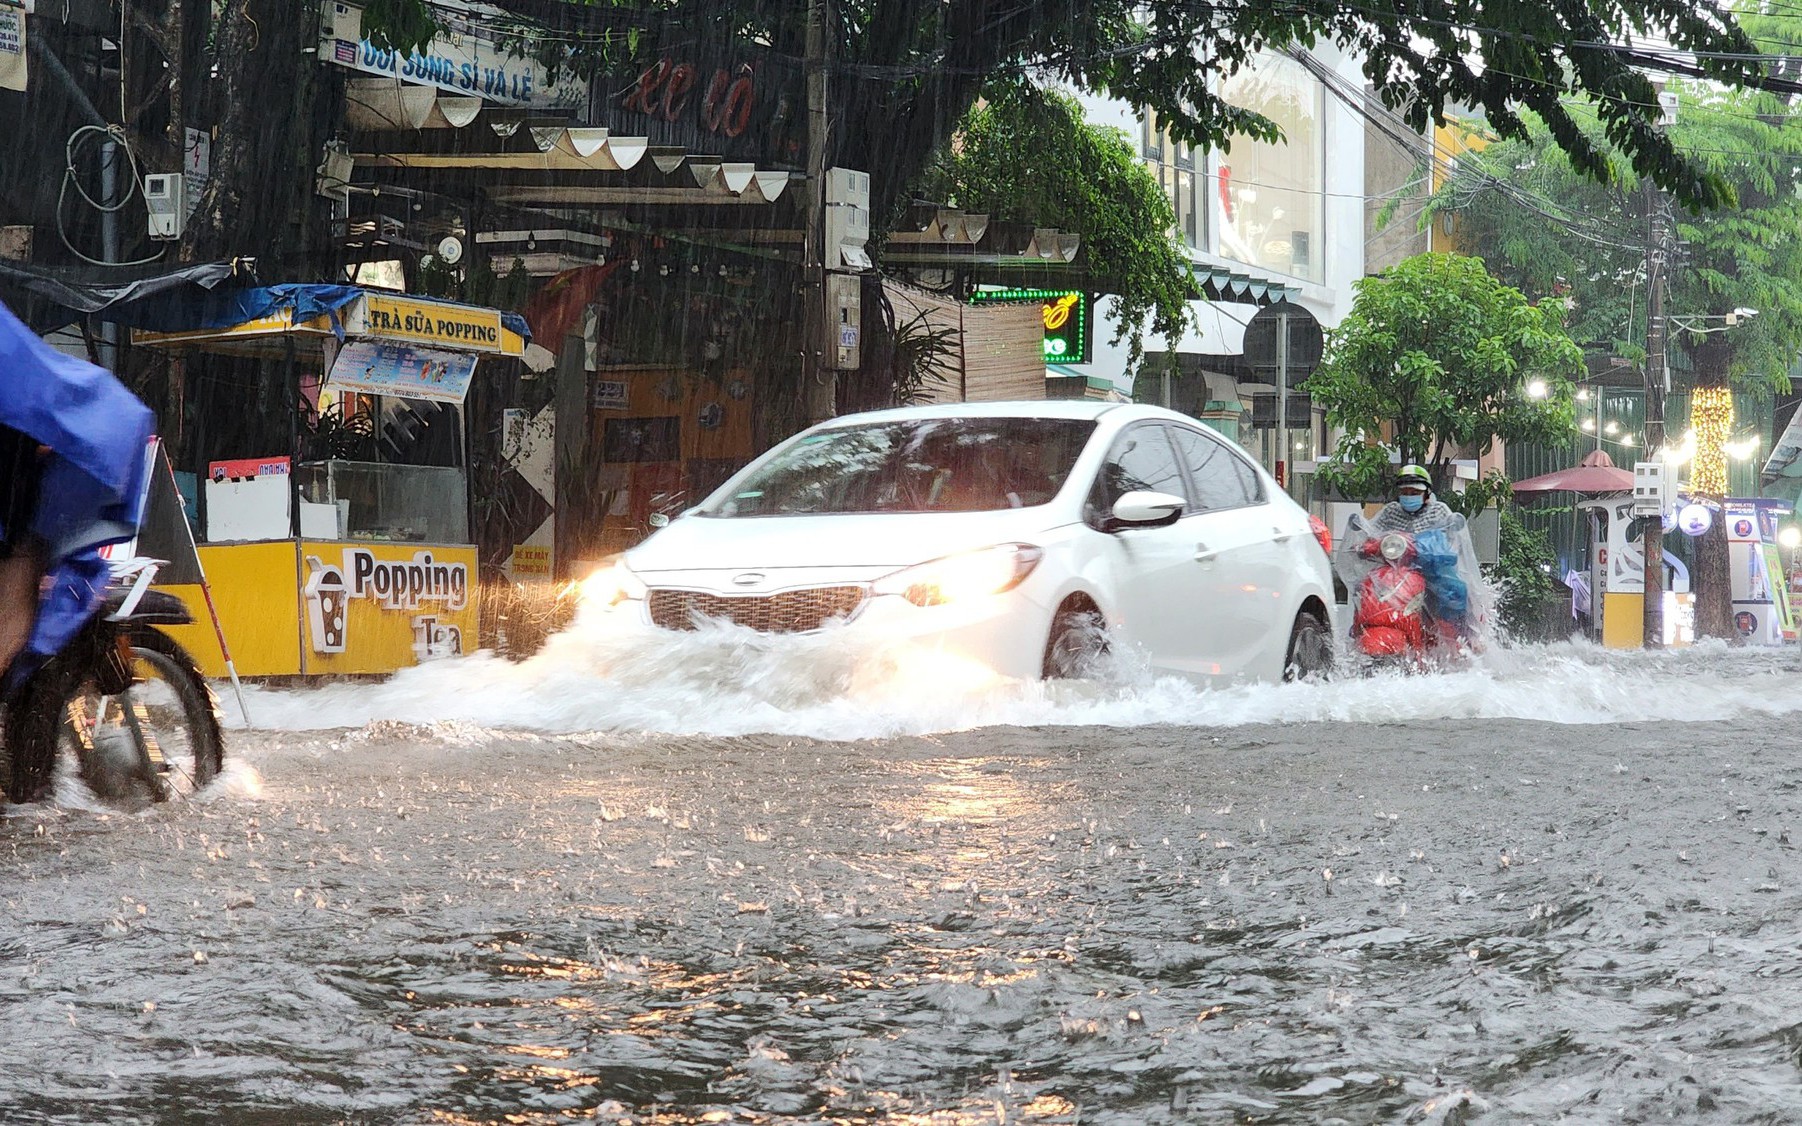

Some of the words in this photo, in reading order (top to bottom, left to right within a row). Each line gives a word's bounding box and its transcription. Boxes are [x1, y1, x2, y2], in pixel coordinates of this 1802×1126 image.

[371, 308, 402, 330] TRÀ
[405, 310, 434, 335] SỮA
[436, 320, 497, 342] POPPING
[355, 552, 465, 605] Popping
[422, 617, 461, 656] Tea
